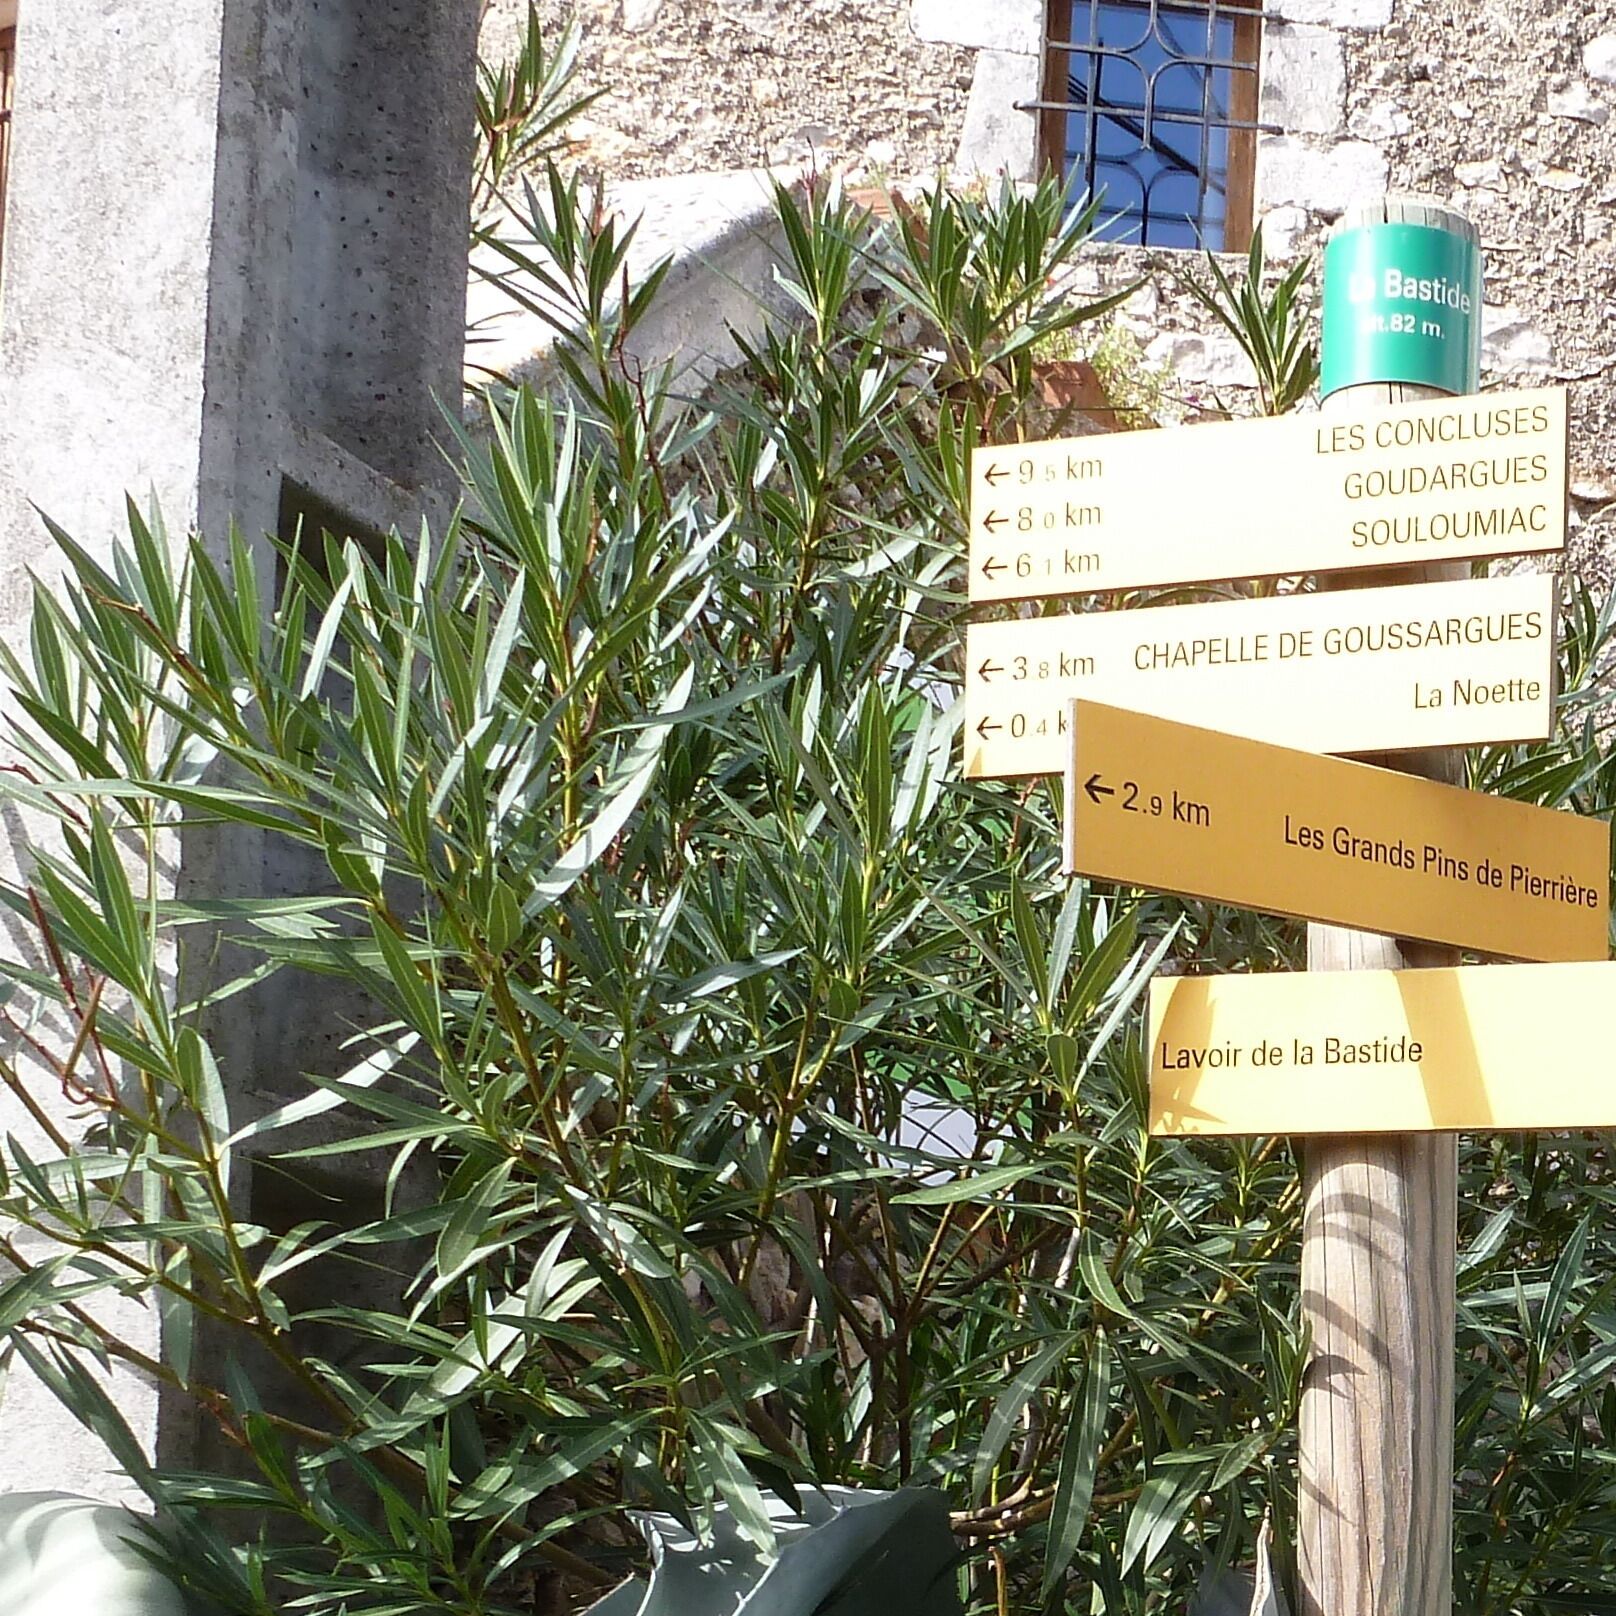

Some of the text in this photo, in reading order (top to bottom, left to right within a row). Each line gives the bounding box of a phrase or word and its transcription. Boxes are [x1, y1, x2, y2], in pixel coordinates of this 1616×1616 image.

[1384, 268, 1471, 314] Bastide
[1317, 405, 1549, 454] LES CONCLUSES
[1067, 455, 1103, 480] km
[1344, 454, 1548, 499] GOUDARGUES
[1065, 502, 1102, 527] km
[1352, 504, 1547, 548] SOULOUMIAC
[1064, 549, 1101, 574] km
[1134, 611, 1543, 670] CHAPELLE DE GOUSSARGUES
[1059, 651, 1095, 677] km
[1415, 678, 1541, 709] La Noette
[1058, 710, 1068, 735] k
[1122, 782, 1210, 827] 2.9 km
[1284, 815, 1598, 908] Les Grands Pins de Pierrière
[1162, 1035, 1423, 1069] Lavoir de la Bastide
